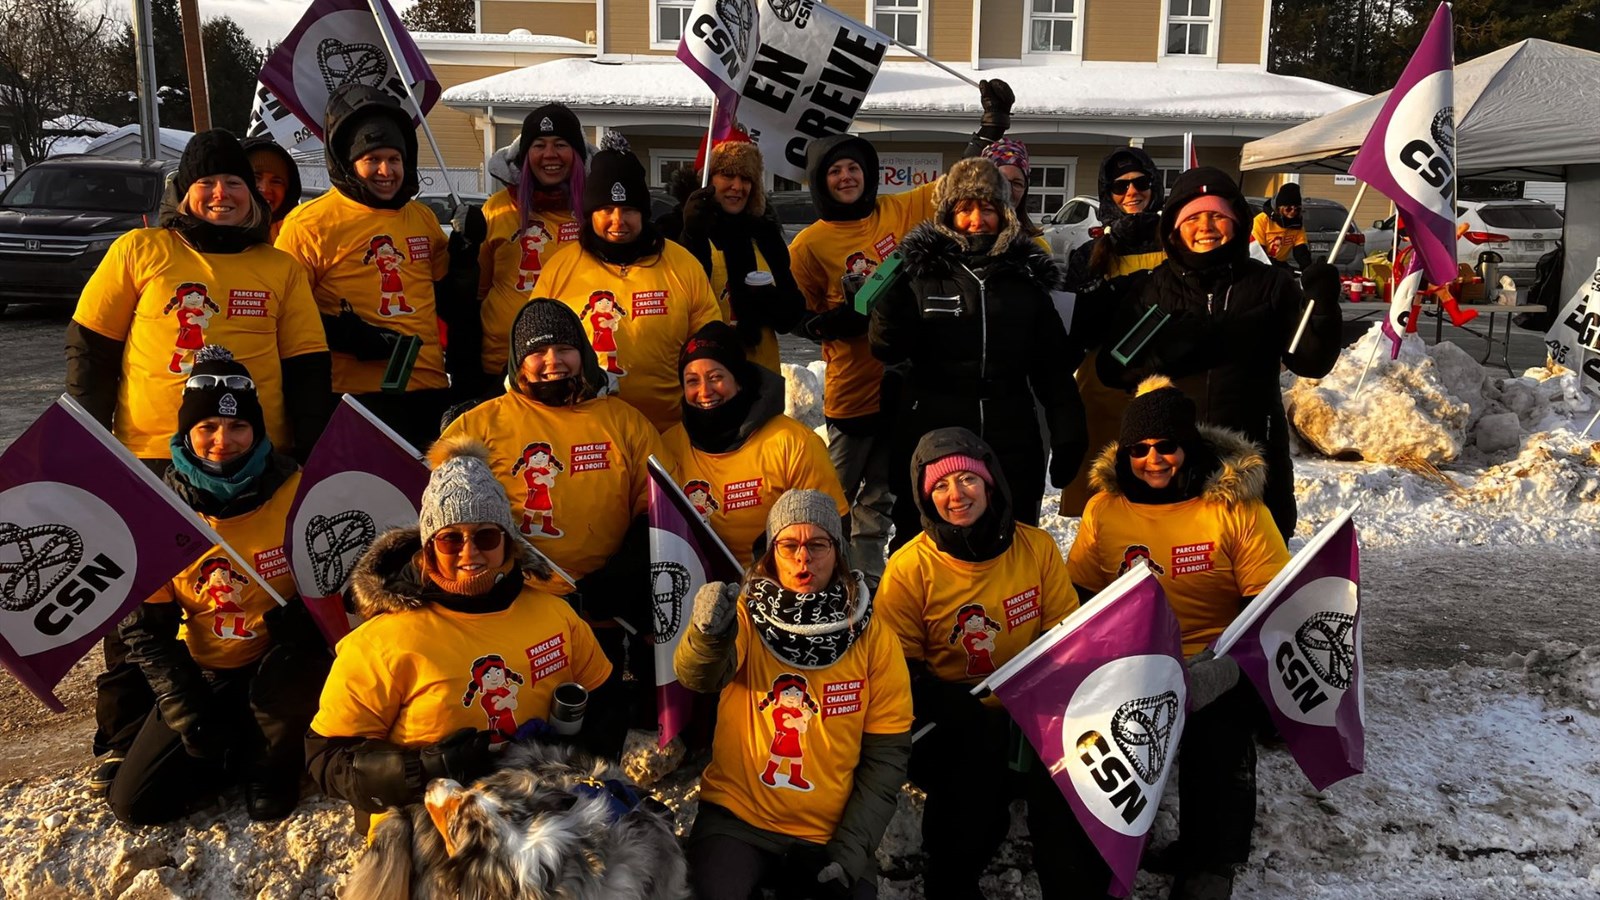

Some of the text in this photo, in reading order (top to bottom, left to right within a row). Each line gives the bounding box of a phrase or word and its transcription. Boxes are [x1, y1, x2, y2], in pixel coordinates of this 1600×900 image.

[692, 13, 740, 81] CSN
[742, 43, 808, 114] EN
[574, 445, 594, 453] PARCE
[574, 453, 603, 462] CHACUNE
[585, 462, 606, 470] DROIT!
[727, 480, 758, 491] PARCE QUE
[727, 490, 754, 500] CHACUNE
[736, 498, 758, 508] DROIT!
[258, 549, 280, 561] PARCE
[1175, 544, 1210, 555] PARCE QUE
[260, 557, 287, 570] CHACUN
[1175, 554, 1205, 564] CHACUNE
[1186, 563, 1210, 573] DROIT!
[34, 553, 125, 636] CSN
[1006, 589, 1036, 607] PARCE QUE
[1008, 600, 1034, 617] CHACUNE
[1020, 608, 1040, 622] DROIT!
[530, 636, 561, 656] PARCE QUE
[534, 649, 561, 667] CHACUNE
[545, 659, 566, 675] DROIT!
[1276, 641, 1329, 715] CSN
[827, 681, 861, 692] PARCE QUE
[827, 693, 857, 704] CHACUNE
[838, 703, 859, 714] DROIT!
[1076, 730, 1148, 826] CSN
